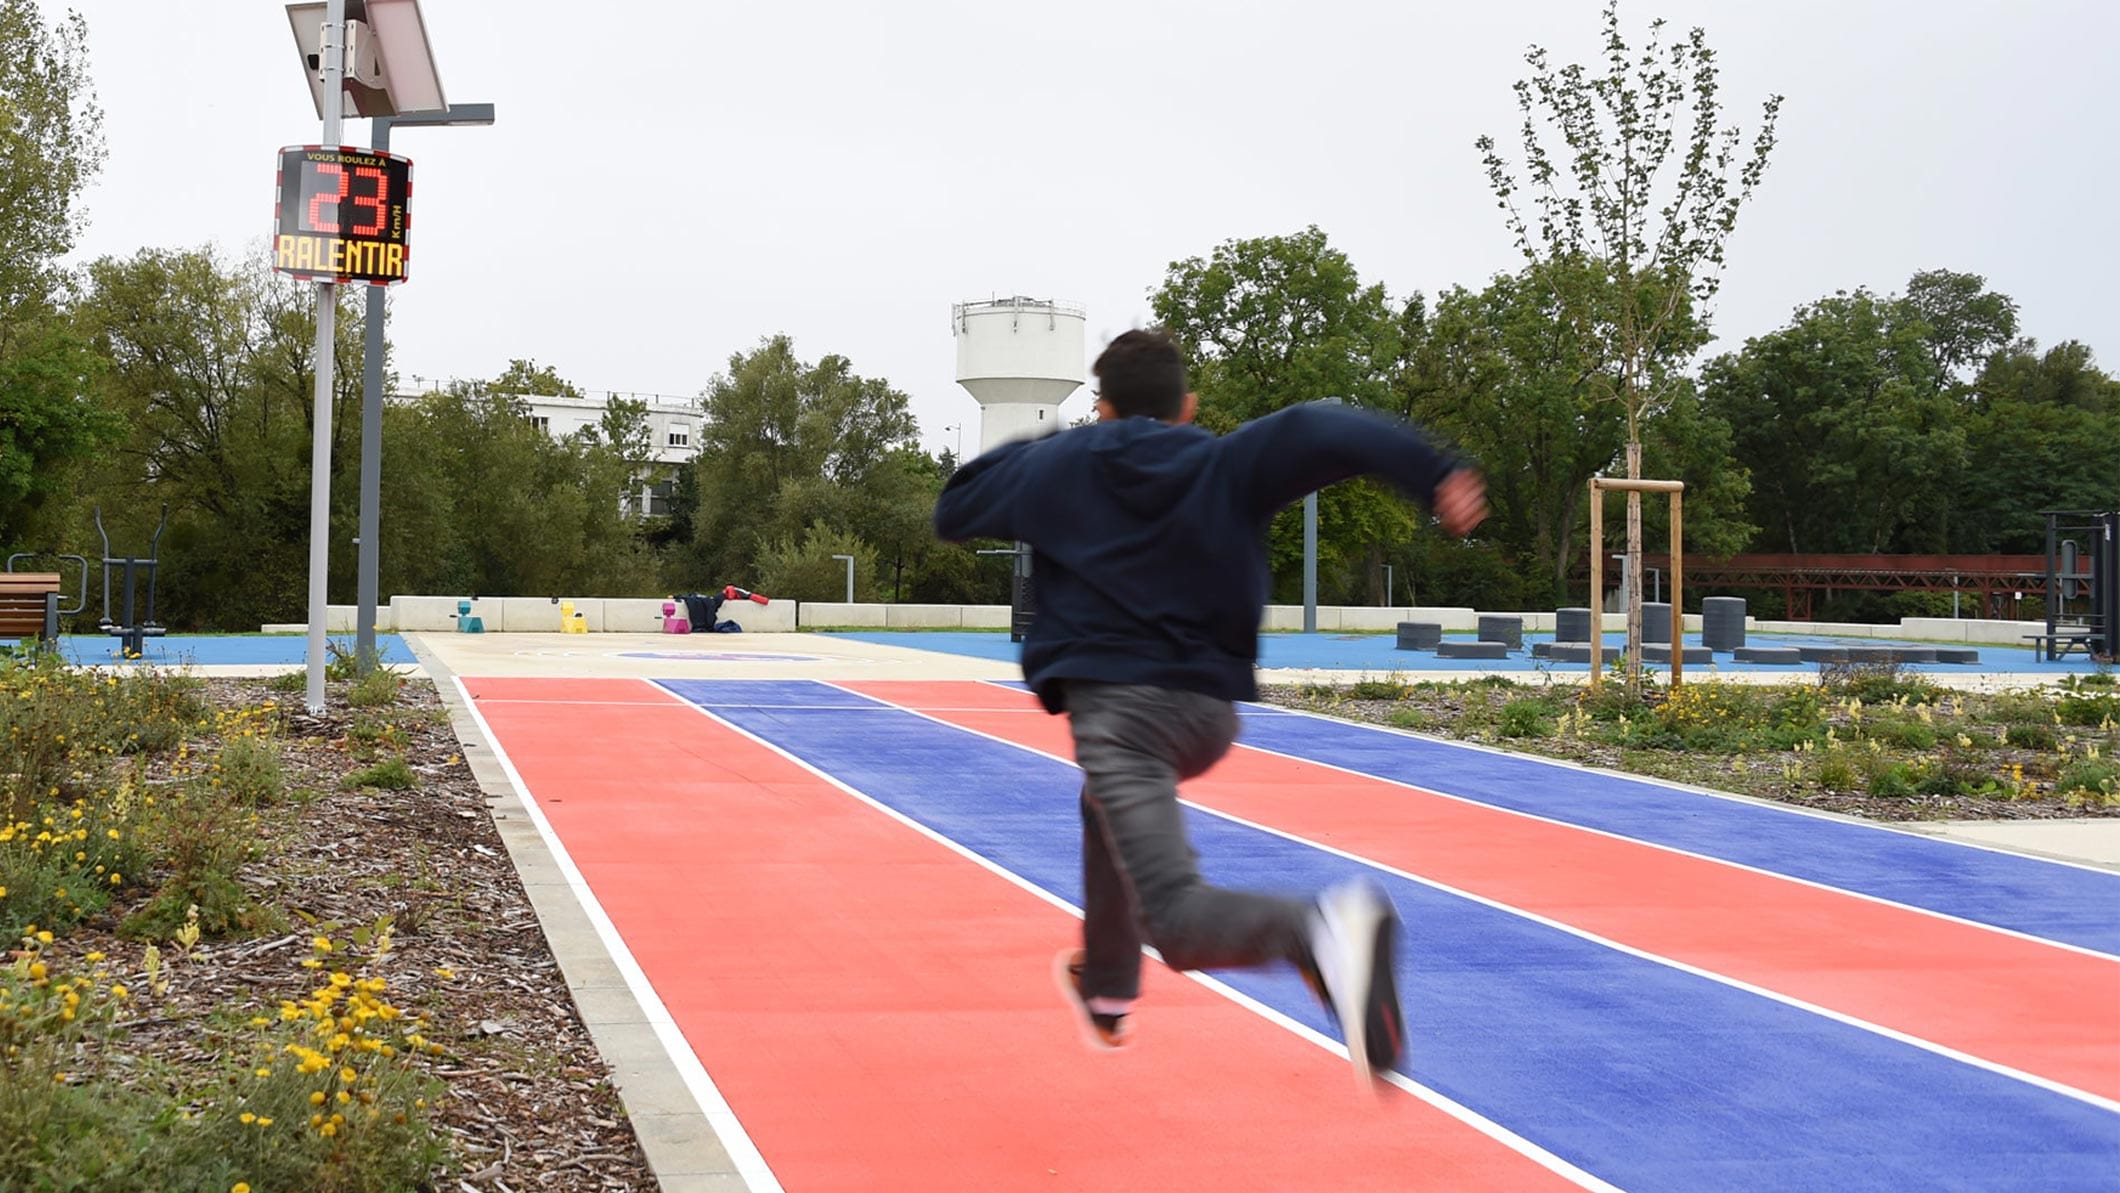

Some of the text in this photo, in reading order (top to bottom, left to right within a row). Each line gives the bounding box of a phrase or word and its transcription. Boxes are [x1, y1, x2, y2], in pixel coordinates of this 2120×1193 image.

[307, 152, 335, 162] VOUS
[338, 154, 376, 166] ROULEZ
[309, 163, 388, 236] 23
[278, 235, 403, 276] RALENTIR
